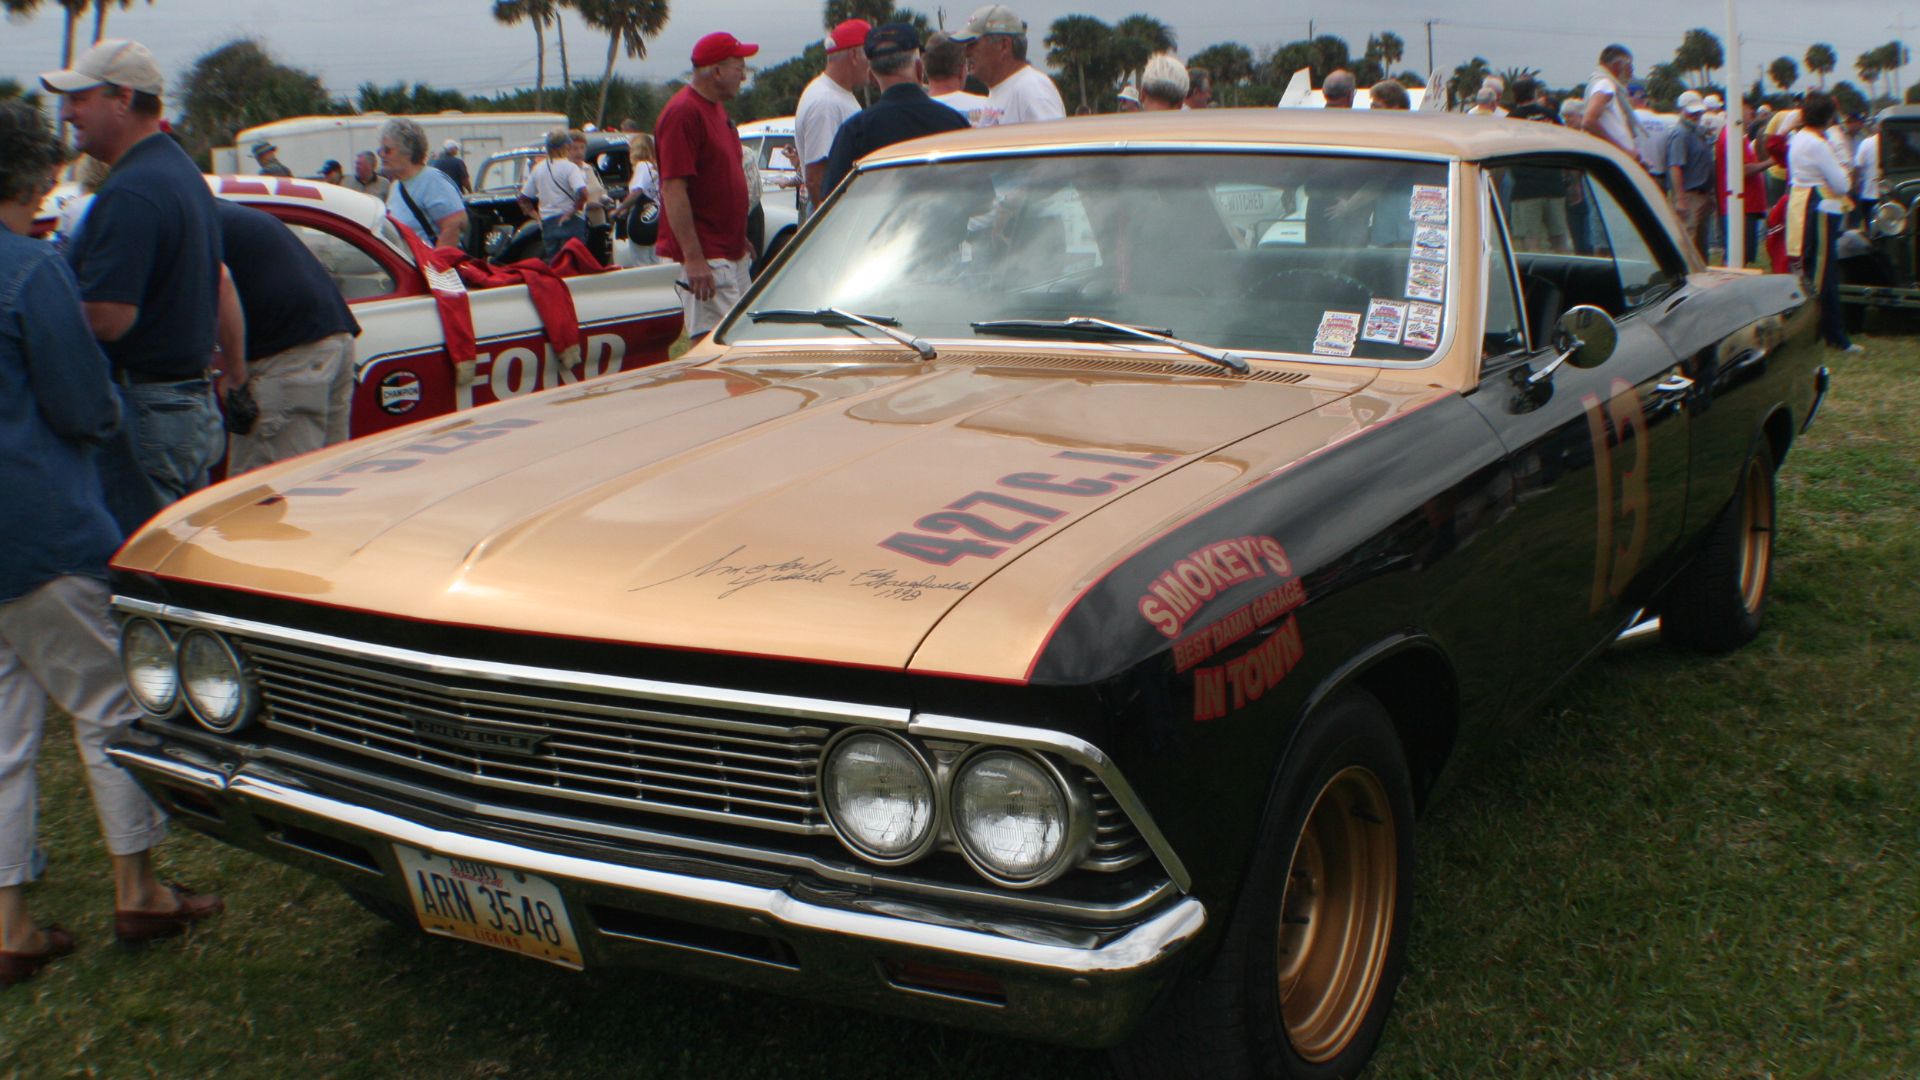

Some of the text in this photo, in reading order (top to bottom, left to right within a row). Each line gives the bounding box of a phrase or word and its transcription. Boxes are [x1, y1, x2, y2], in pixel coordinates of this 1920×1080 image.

[455, 333, 627, 412] FORD
[1582, 376, 1651, 614] 13
[1139, 536, 1293, 639] SMOKEY'S
[1173, 577, 1306, 673] BEST DAMN GARAGE
[1194, 614, 1304, 721] IN TOWN
[420, 719, 523, 747] CHEVELLE
[417, 869, 562, 947] ARN 3548
[450, 859, 499, 880] OHIO
